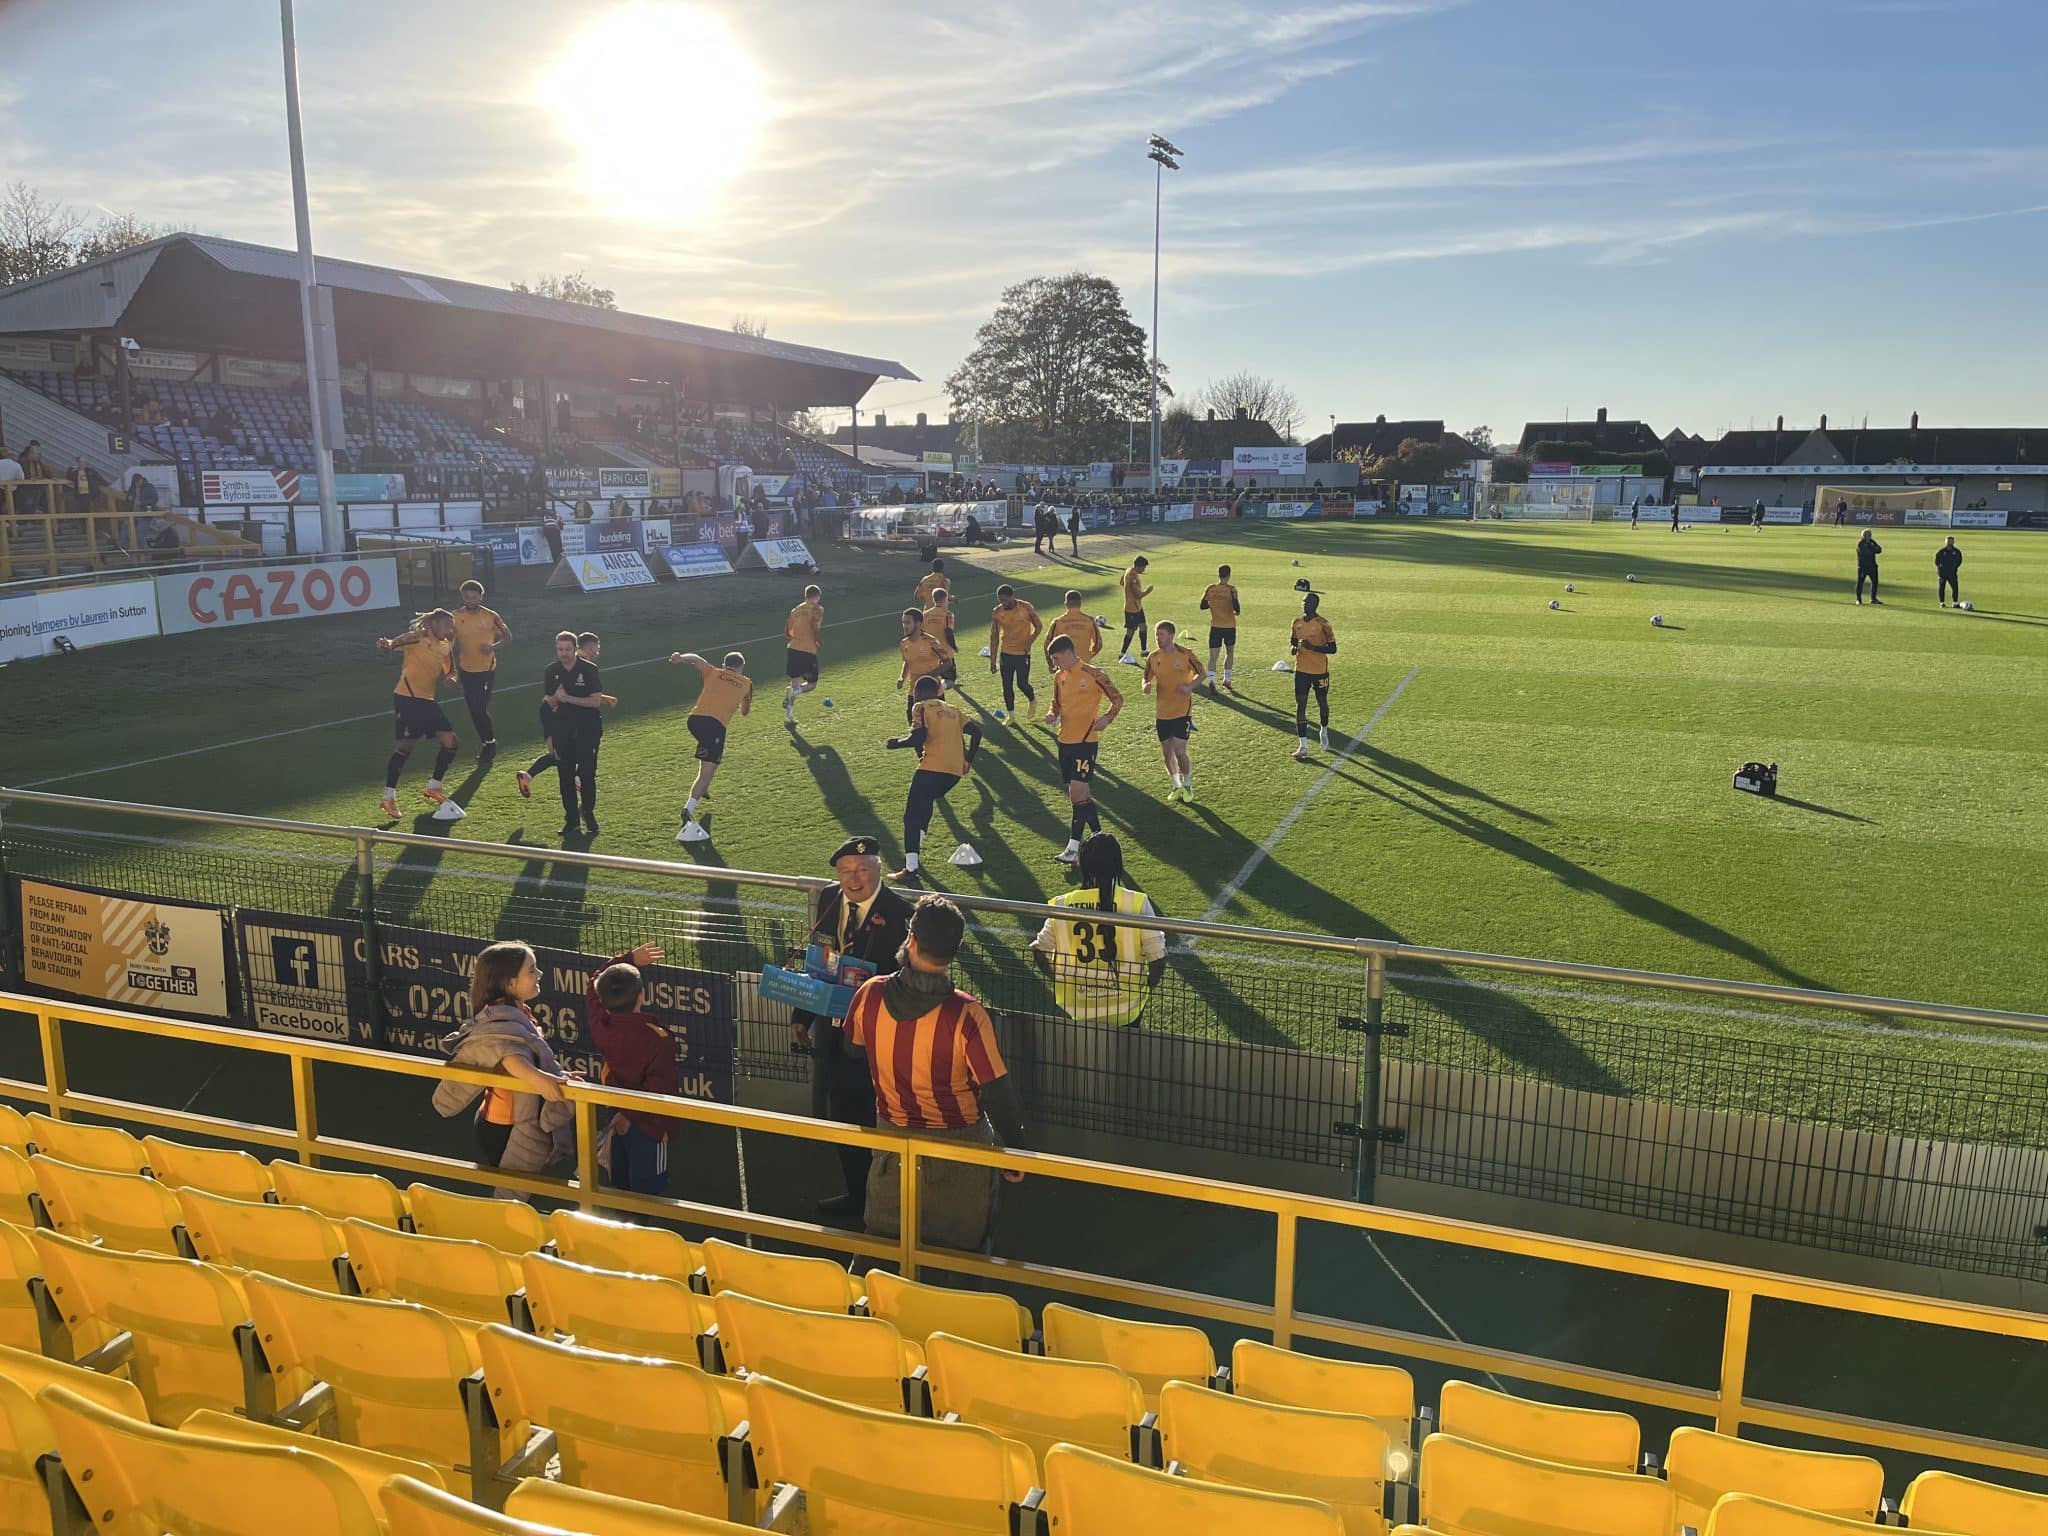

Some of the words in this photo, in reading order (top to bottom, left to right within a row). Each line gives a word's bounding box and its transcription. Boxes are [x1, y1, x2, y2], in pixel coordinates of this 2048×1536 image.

[114, 437, 124, 450] E
[222, 480, 243, 490] Smith
[625, 473, 647, 484] GLASS
[224, 490, 250, 501] Byford
[1200, 505, 1229, 517] Lifebuoy
[1856, 511, 1872, 521] sky
[1877, 511, 1894, 520] bet
[699, 523, 716, 540] sky
[720, 524, 735, 538] bet
[601, 553, 642, 570] ANGEL
[610, 570, 654, 584] PLASTICS
[187, 565, 371, 624] CAZOO
[0, 624, 31, 639] pioning
[32, 618, 68, 633] Hampers
[69, 614, 79, 626] by
[80, 611, 108, 623] Lauren
[110, 608, 117, 619] in
[118, 606, 147, 618] Sutton
[1075, 759, 1089, 772] 14
[29, 895, 55, 909] PLEASE
[56, 900, 87, 916] REFRAIN
[29, 908, 50, 921] FROM
[50, 911, 65, 924] ANY
[30, 921, 93, 943] DISCRIMINATORY
[30, 934, 41, 945] OR
[41, 936, 88, 955] ANTI-SOCIAL
[31, 946, 72, 965] BEHAVIOUR
[73, 955, 83, 966] IN
[31, 959, 46, 971] OUR
[47, 963, 81, 979] STADIUM
[129, 972, 195, 994] TOGETHER
[259, 1007, 344, 1035] Facebook
